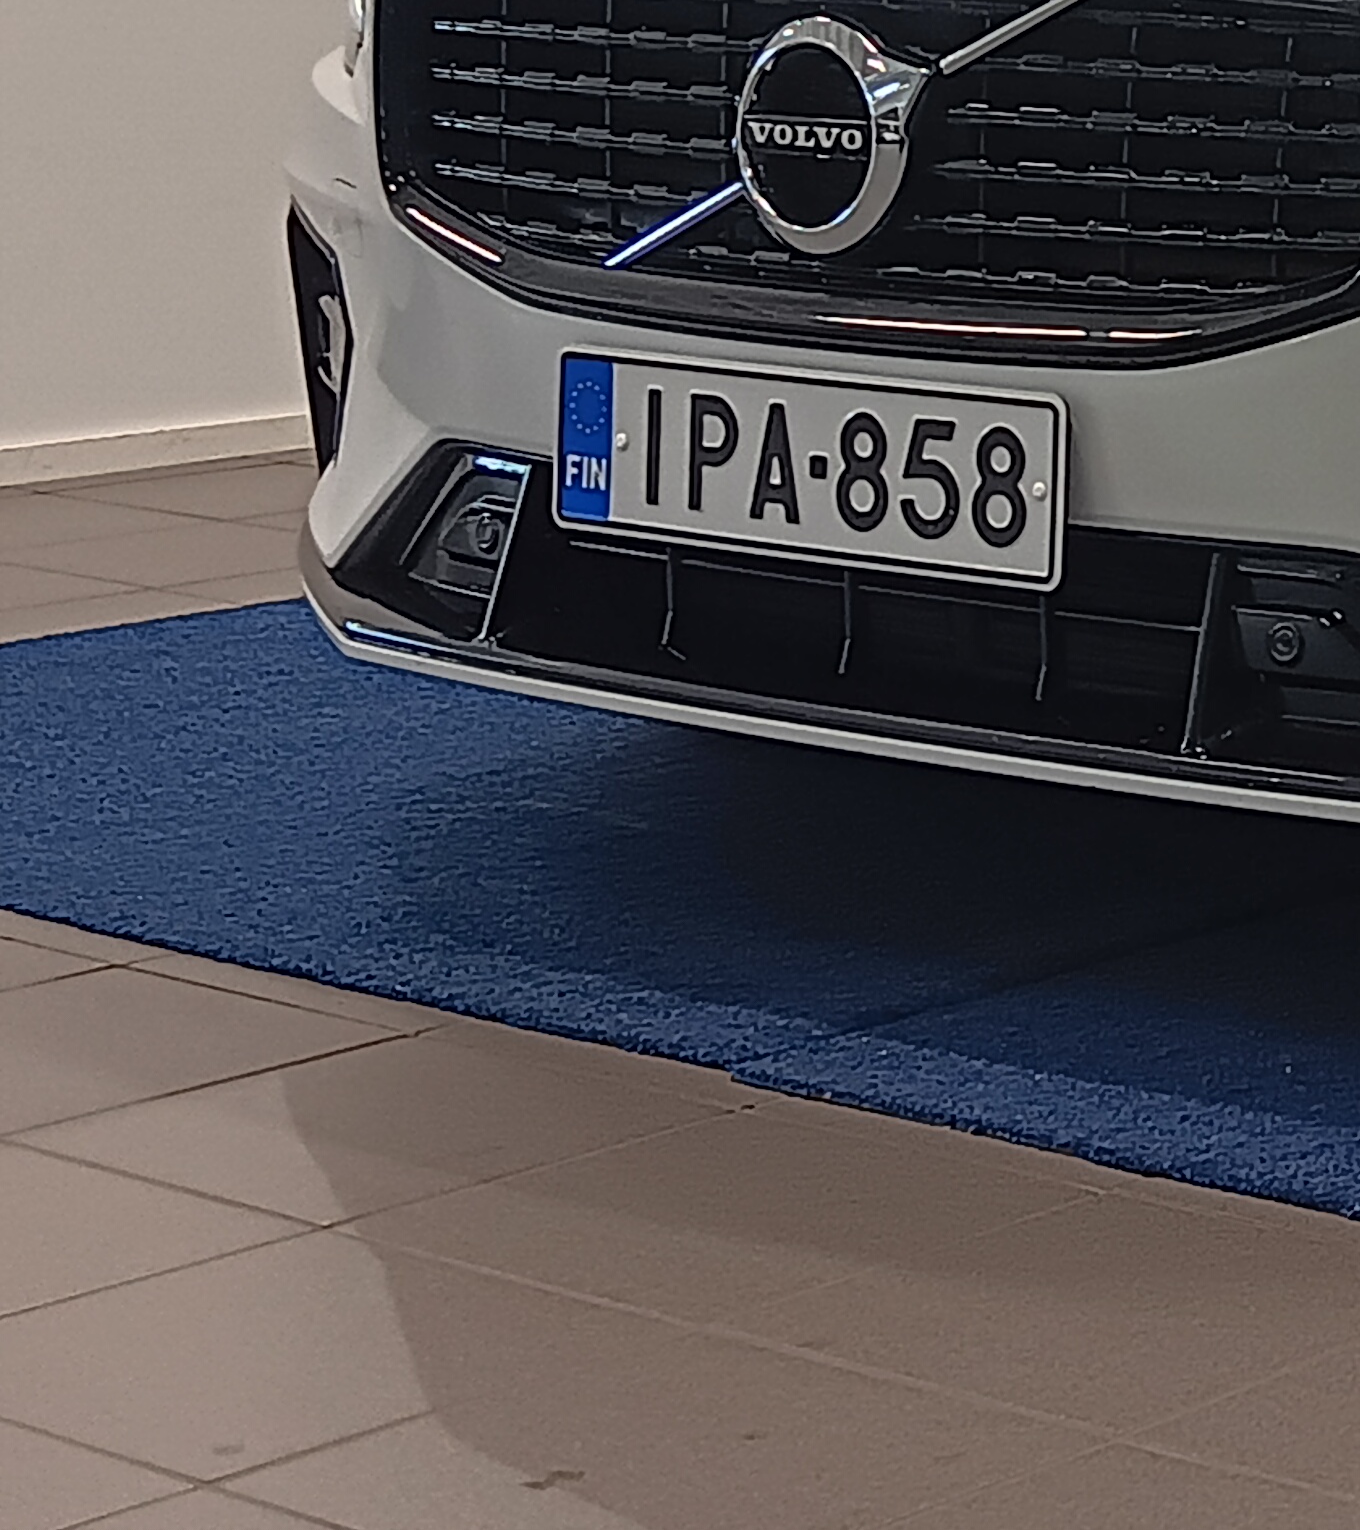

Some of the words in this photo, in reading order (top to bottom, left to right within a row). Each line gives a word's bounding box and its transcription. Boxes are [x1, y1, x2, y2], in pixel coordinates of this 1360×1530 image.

[747, 121, 864, 151] VOLVO
[564, 454, 607, 491] FIN
[645, 386, 1028, 548] IPA-858
